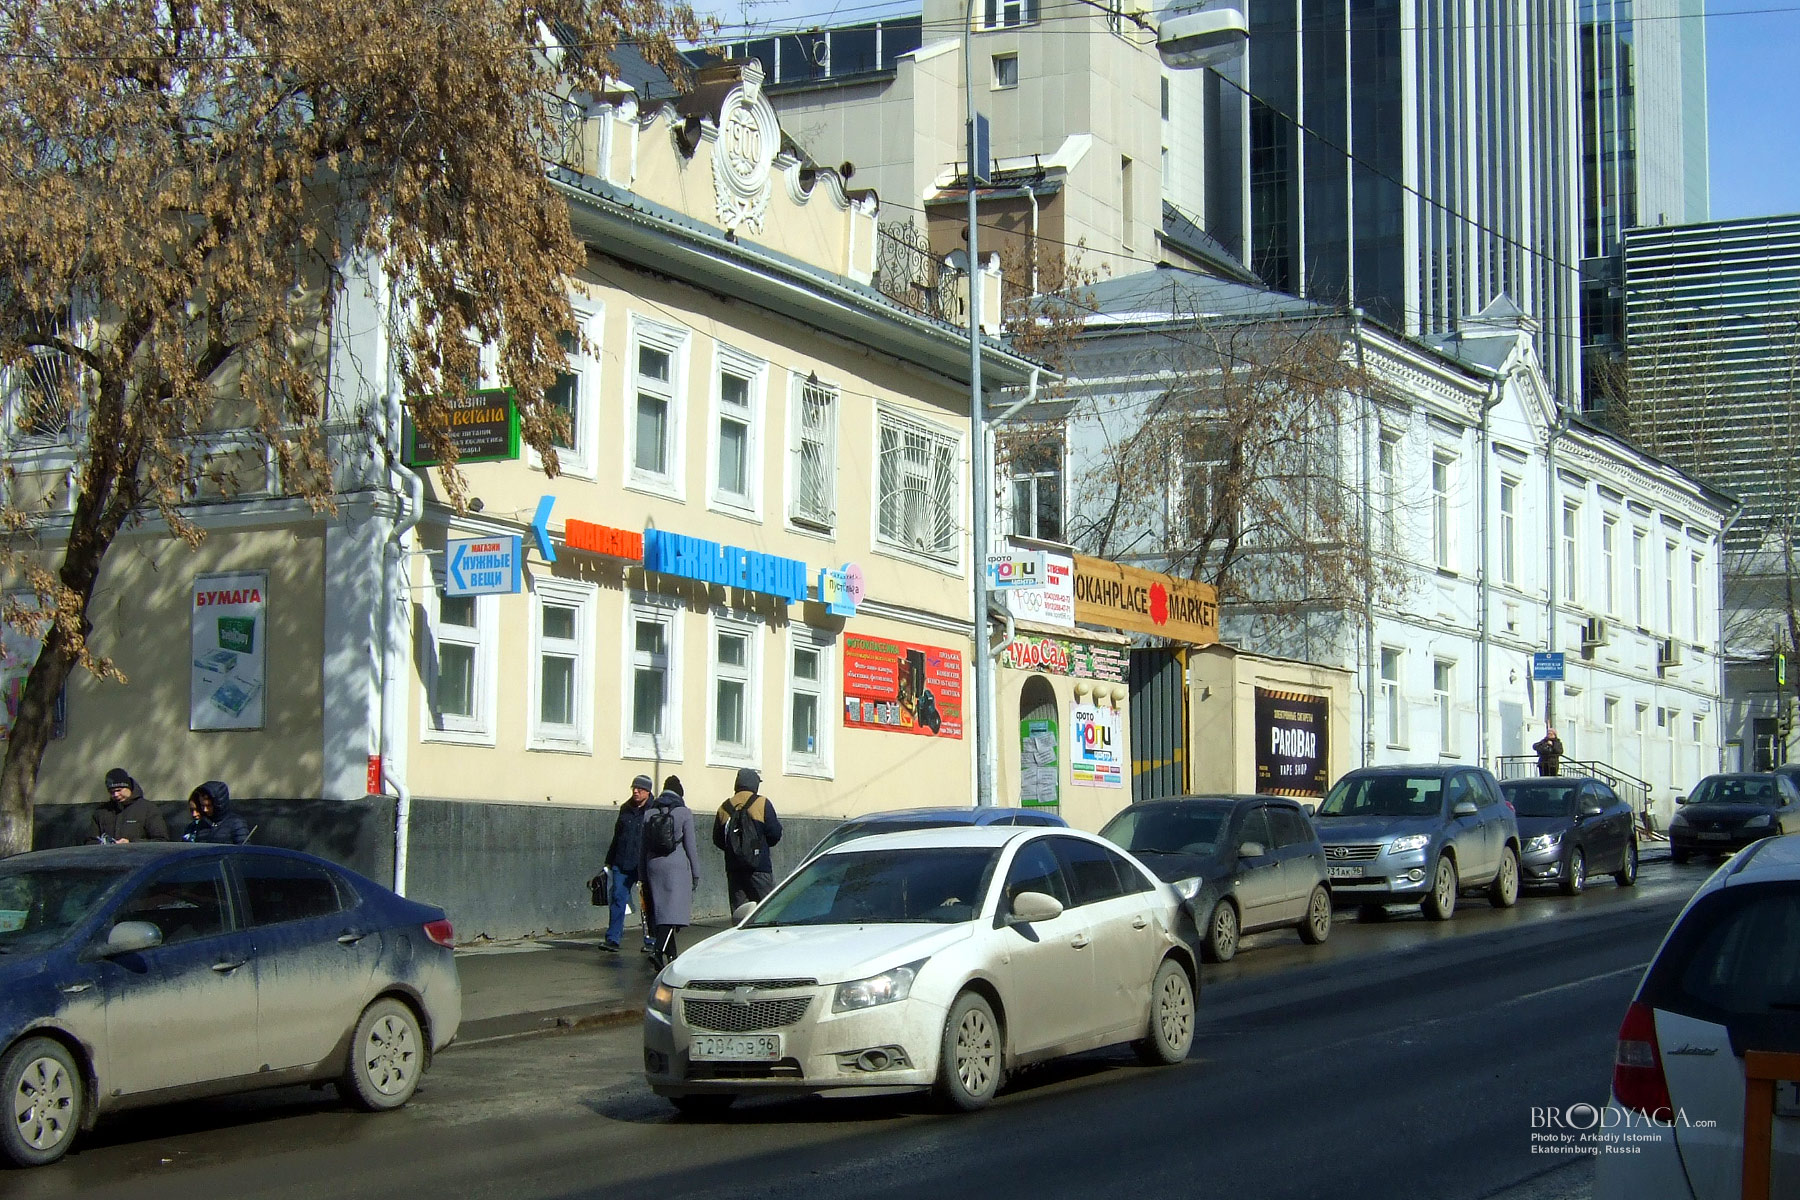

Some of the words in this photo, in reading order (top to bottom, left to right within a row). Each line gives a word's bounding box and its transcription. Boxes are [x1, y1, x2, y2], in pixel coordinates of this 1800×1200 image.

[471, 543, 500, 552] МАГАЗИН
[462, 553, 510, 570] НУЖНЫЕ
[565, 518, 643, 561] МАГАЗИН
[644, 528, 747, 590] НУЖНЫЕ
[747, 550, 807, 605] ВЕЩИ
[470, 571, 502, 588] ВЕЩИ
[196, 588, 261, 607] БУМАГА
[1074, 574, 1148, 614] OKAHPLACE
[1169, 594, 1216, 627] MARKET
[1280, 764, 1292, 776] VAPE
[1294, 763, 1307, 775] SHOP
[758, 1037, 773, 1050] 96
